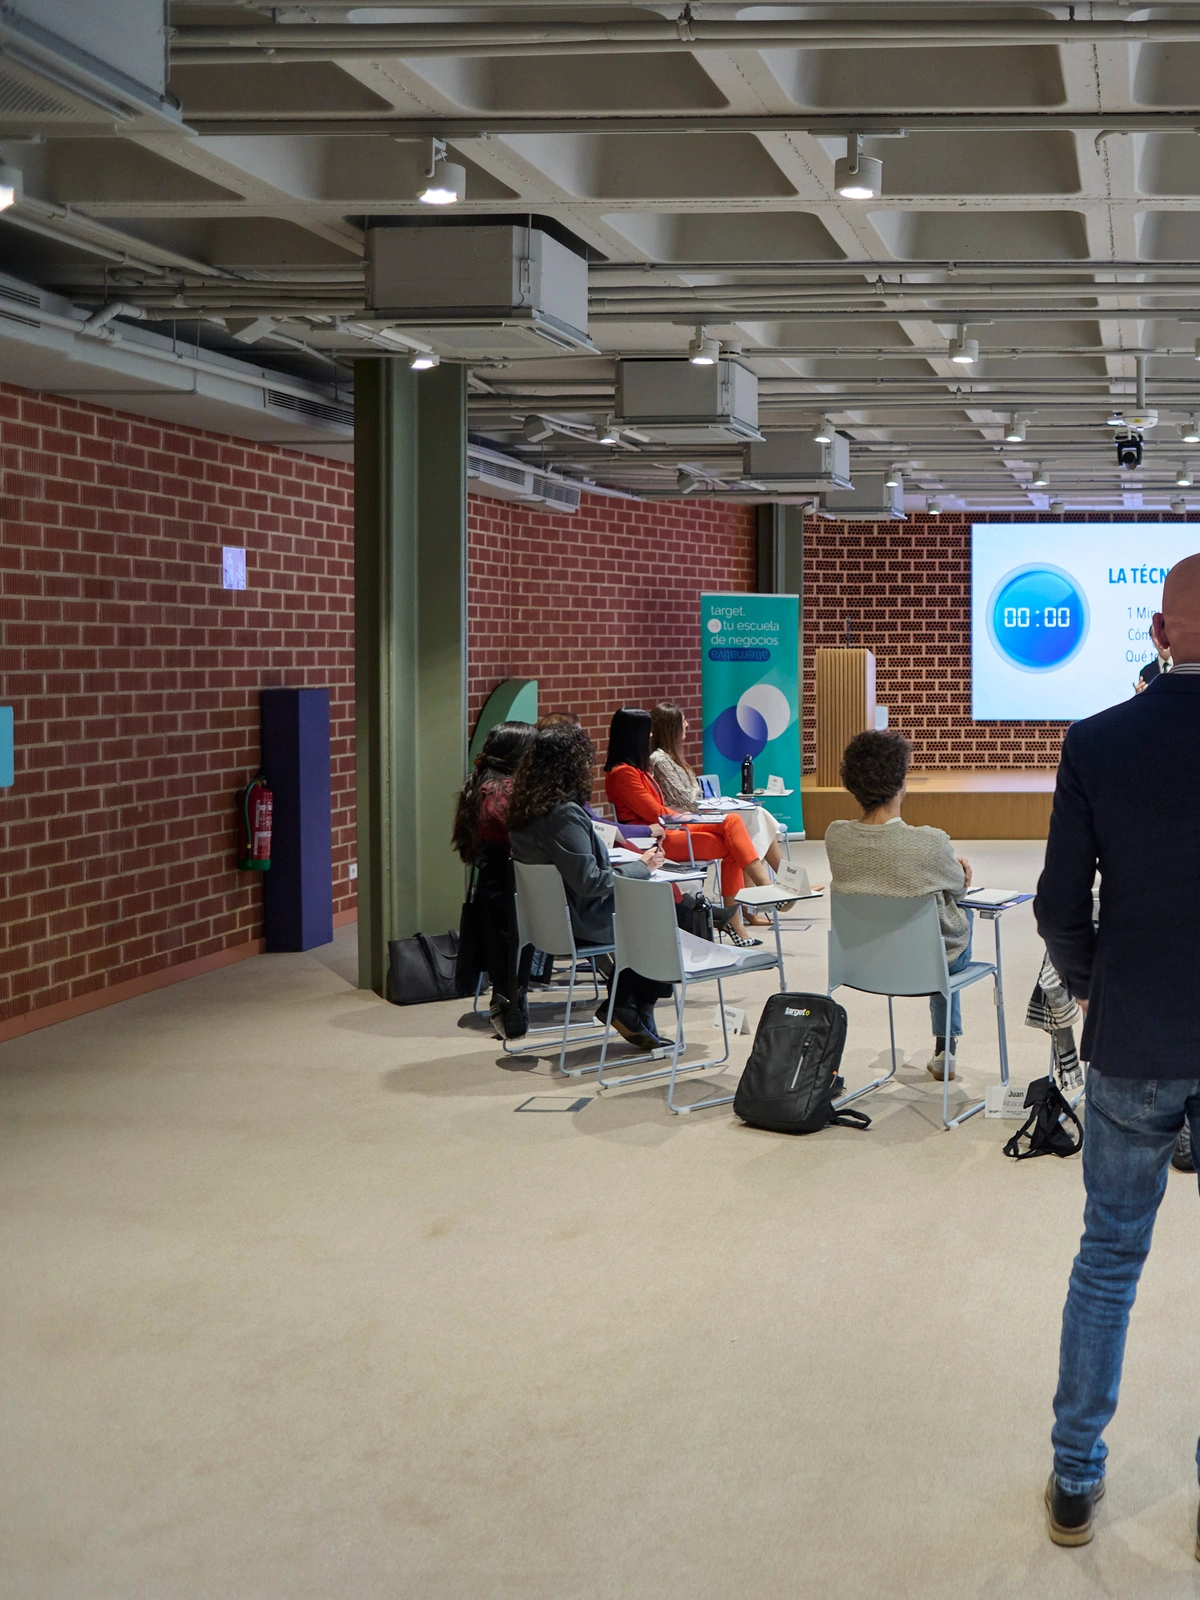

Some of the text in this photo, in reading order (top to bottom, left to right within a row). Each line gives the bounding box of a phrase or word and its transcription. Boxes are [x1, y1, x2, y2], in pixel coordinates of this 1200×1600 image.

[1108, 568, 1127, 584] LA
[1130, 564, 1168, 584] TÉCN
[710, 605, 746, 619] target.
[1004, 607, 1070, 628] 00:00
[1127, 606, 1160, 619] 1 Min
[723, 620, 780, 631] tu escuela
[710, 634, 779, 648] de negocios
[1128, 628, 1153, 641] Cóm
[1125, 649, 1148, 663] Qué
[1007, 1090, 1024, 1098] Juan
